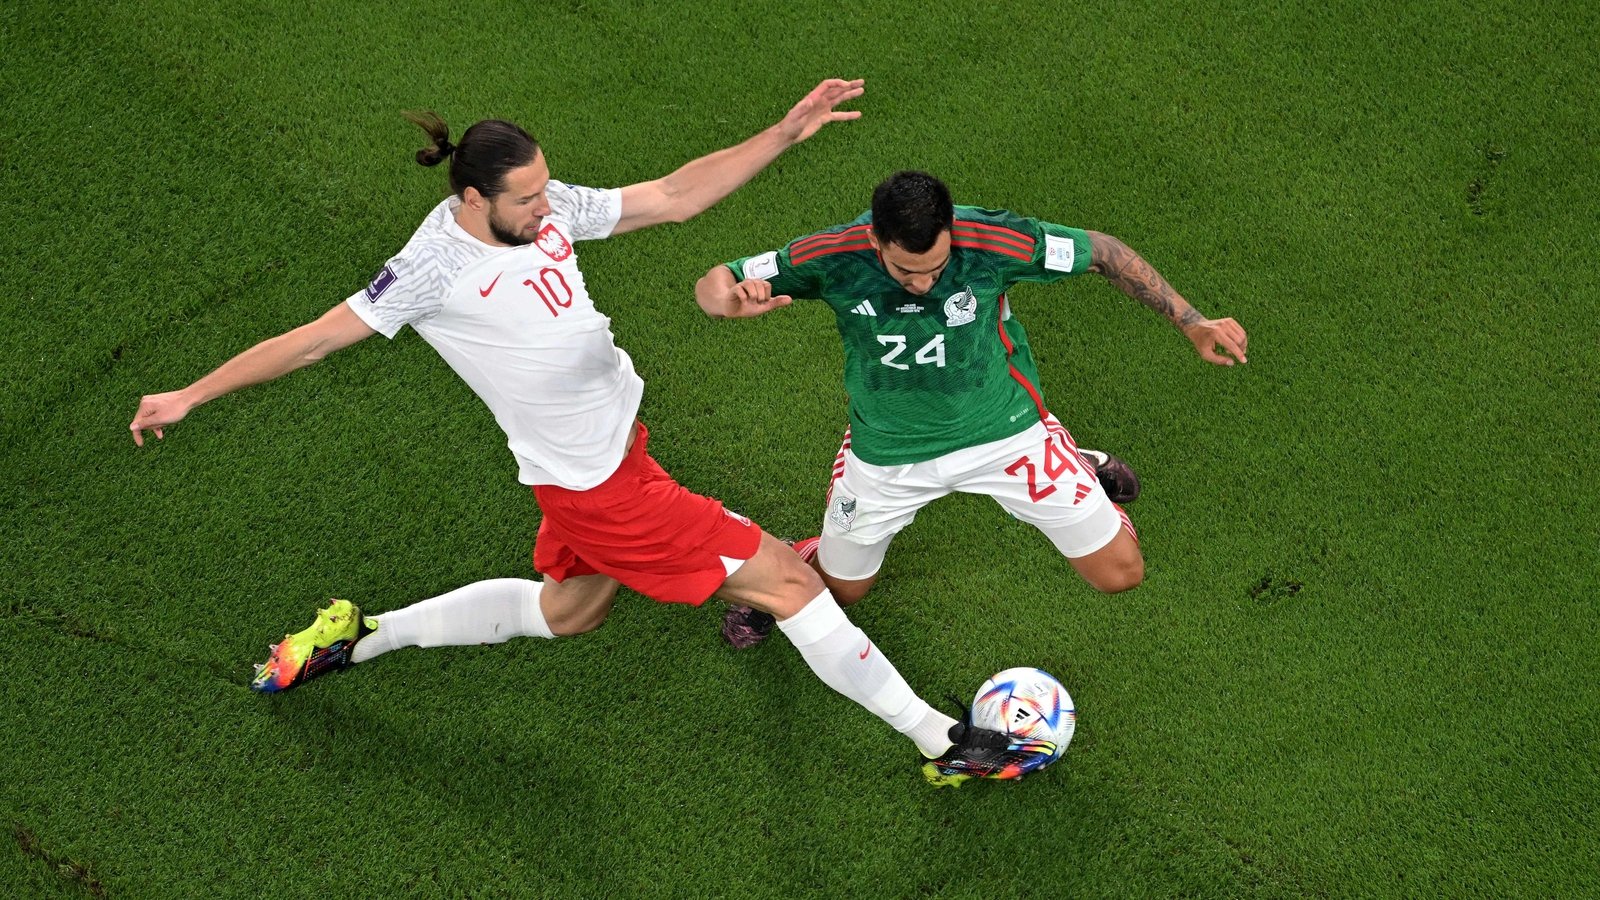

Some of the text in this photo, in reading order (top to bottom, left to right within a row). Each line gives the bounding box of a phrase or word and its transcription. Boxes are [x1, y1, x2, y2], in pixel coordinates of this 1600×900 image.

[523, 268, 573, 318] 10
[877, 334, 946, 370] 24
[1004, 436, 1078, 503] 24
